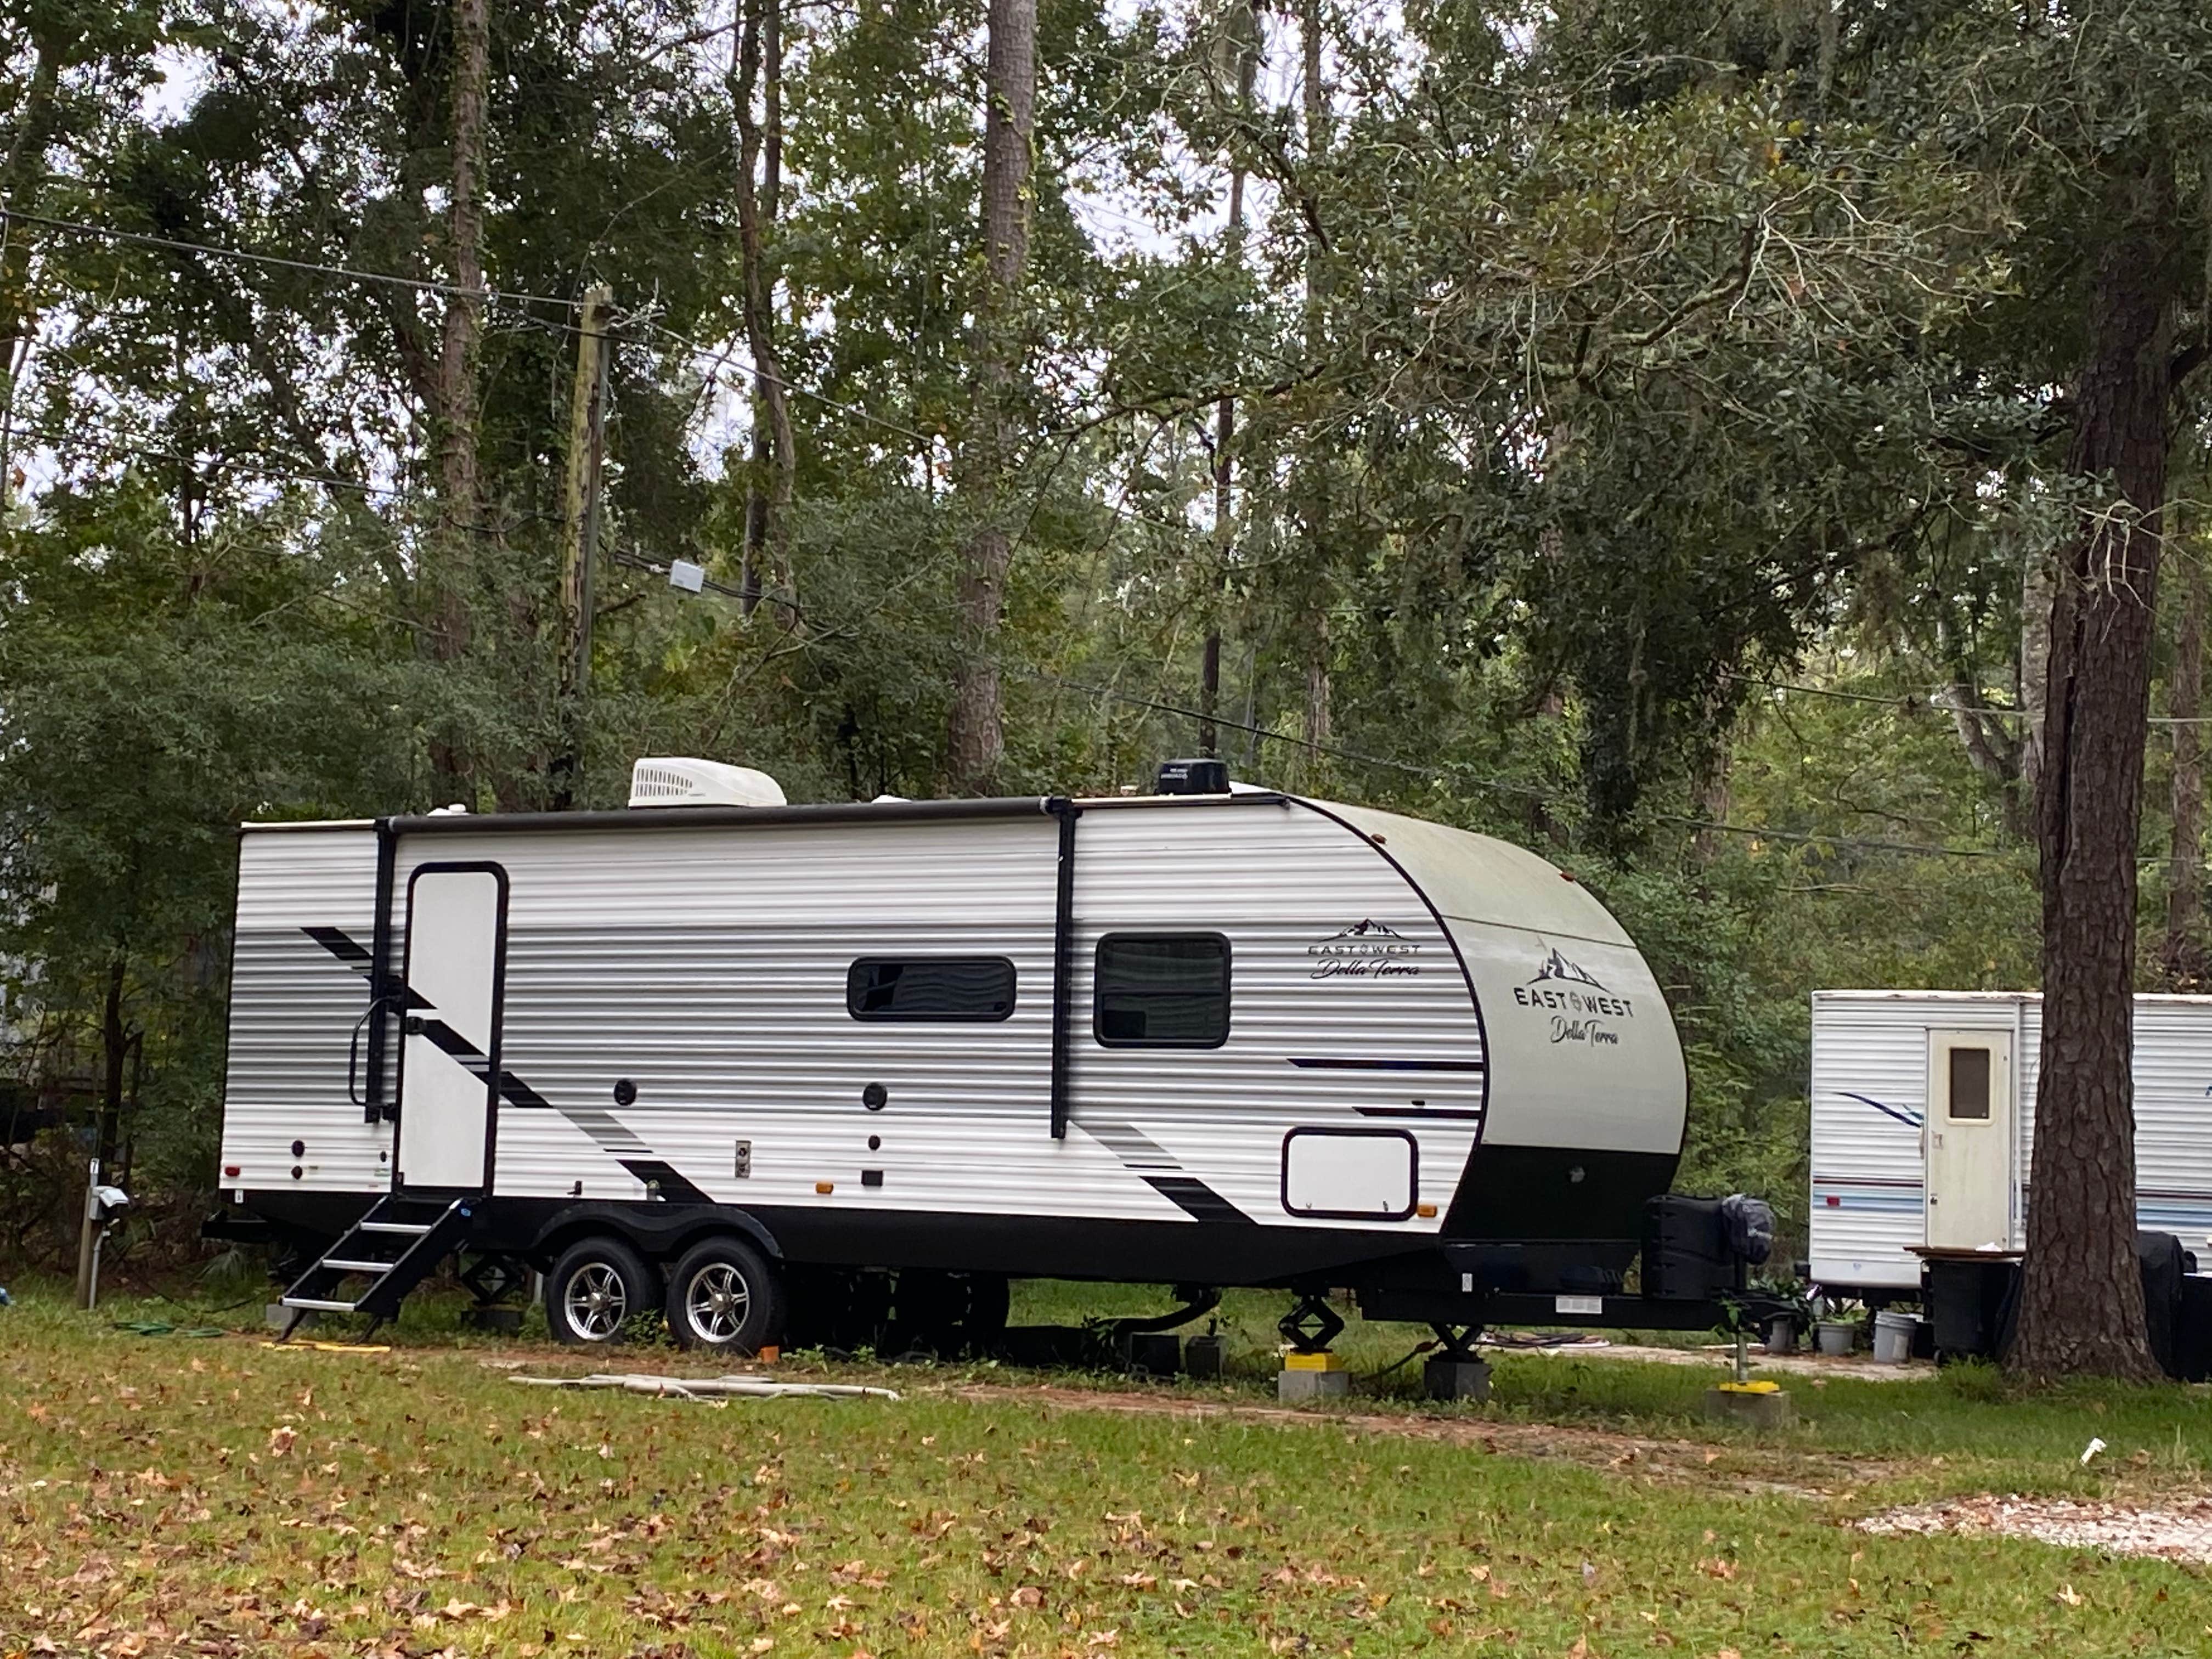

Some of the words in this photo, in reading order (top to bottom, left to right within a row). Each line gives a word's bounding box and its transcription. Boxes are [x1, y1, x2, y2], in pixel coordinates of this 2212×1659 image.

[1308, 945, 1355, 955] EAST
[1372, 945, 1421, 955] WEST
[1310, 958, 1367, 979] Della
[1369, 957, 1421, 979] Terra
[1514, 988, 1567, 1010] EAST
[1582, 995, 1633, 1018] WEST
[1550, 1015, 1585, 1043] Della
[1585, 1019, 1618, 1047] Terra
